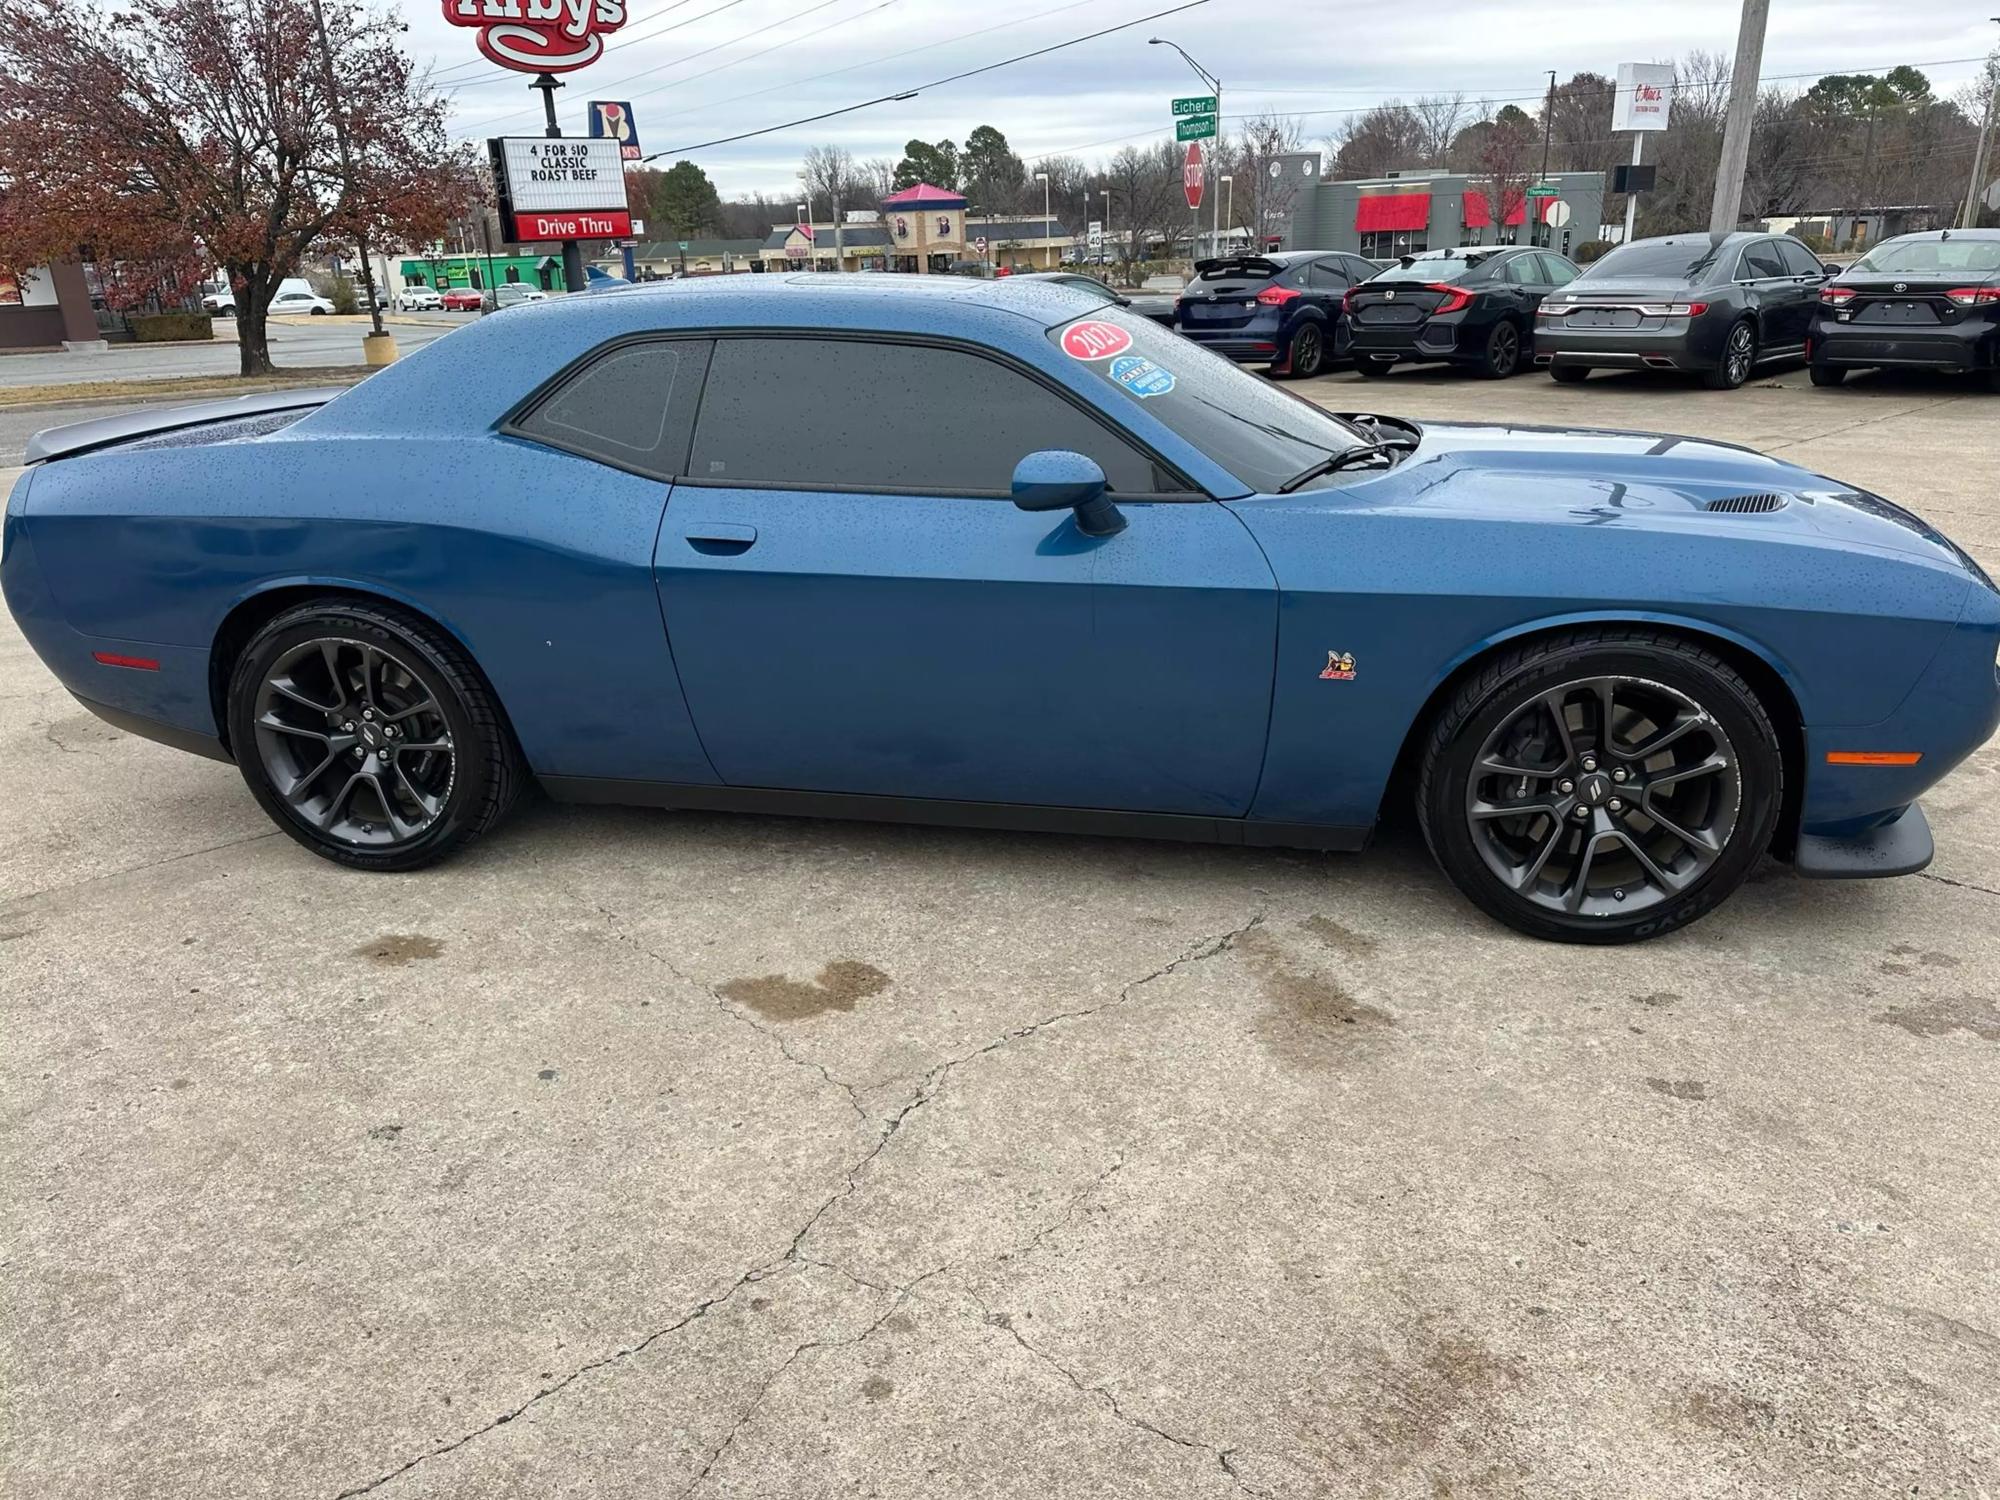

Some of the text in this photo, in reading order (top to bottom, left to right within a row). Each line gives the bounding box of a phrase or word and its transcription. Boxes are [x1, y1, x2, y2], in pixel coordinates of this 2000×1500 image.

[1173, 101, 1205, 113] Eicher
[1179, 121, 1210, 137] Thompson
[530, 145, 588, 156] 4 FOR $10
[541, 157, 587, 169] CLASSIC
[531, 170, 597, 181] ROAST BEEF
[1186, 164, 1202, 187] STOP
[537, 217, 613, 235] Drive Thru
[1090, 236, 1101, 246] 40
[1072, 323, 1120, 356] 2021
